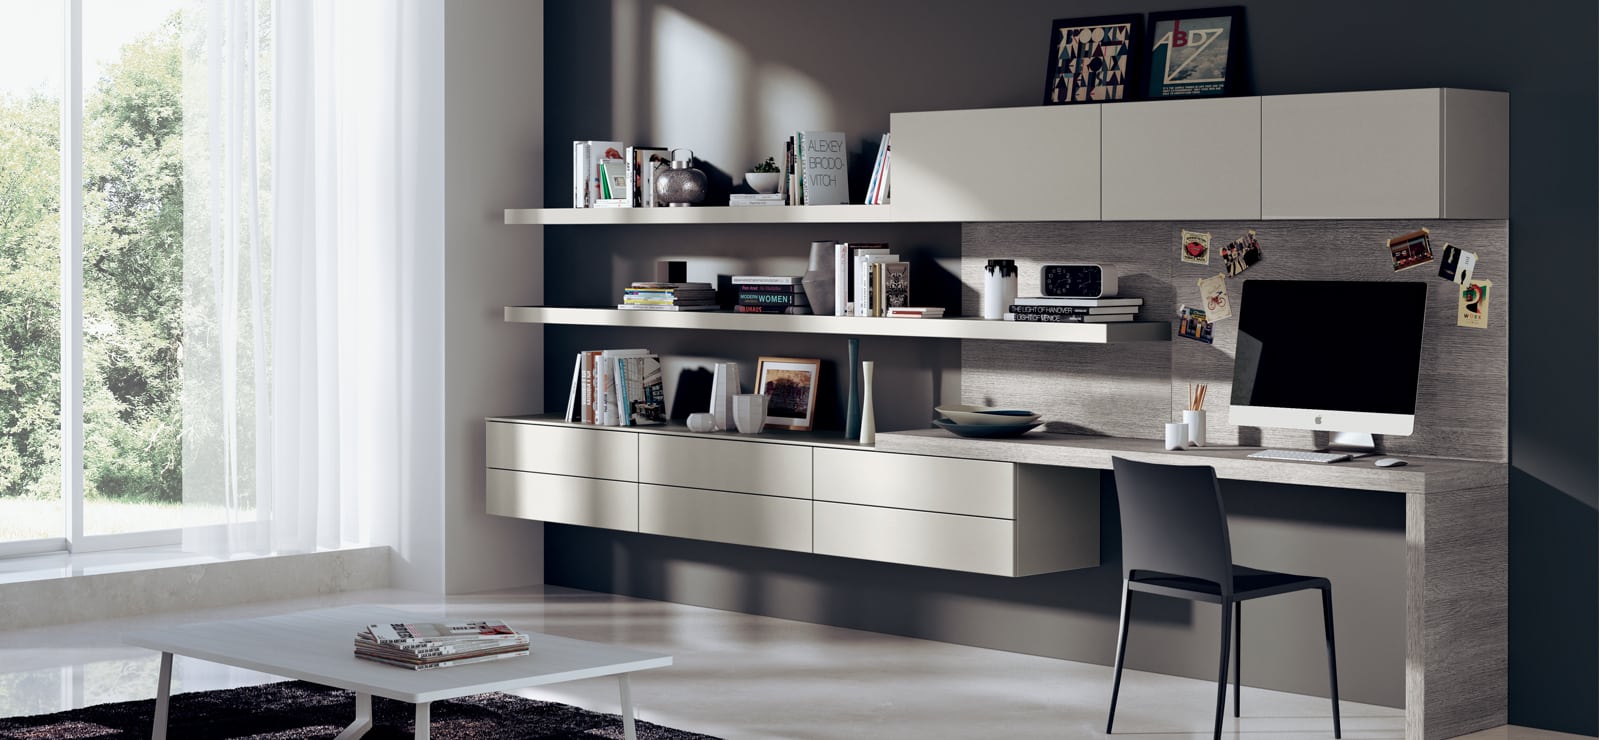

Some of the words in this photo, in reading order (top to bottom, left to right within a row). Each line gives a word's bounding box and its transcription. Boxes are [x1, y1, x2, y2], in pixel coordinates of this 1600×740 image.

[808, 139, 843, 152] ALEXEY
[809, 156, 845, 169] BRODO-
[810, 174, 837, 187] VITCH
[758, 295, 788, 303] WOMEN
[1011, 305, 1022, 313] THE
